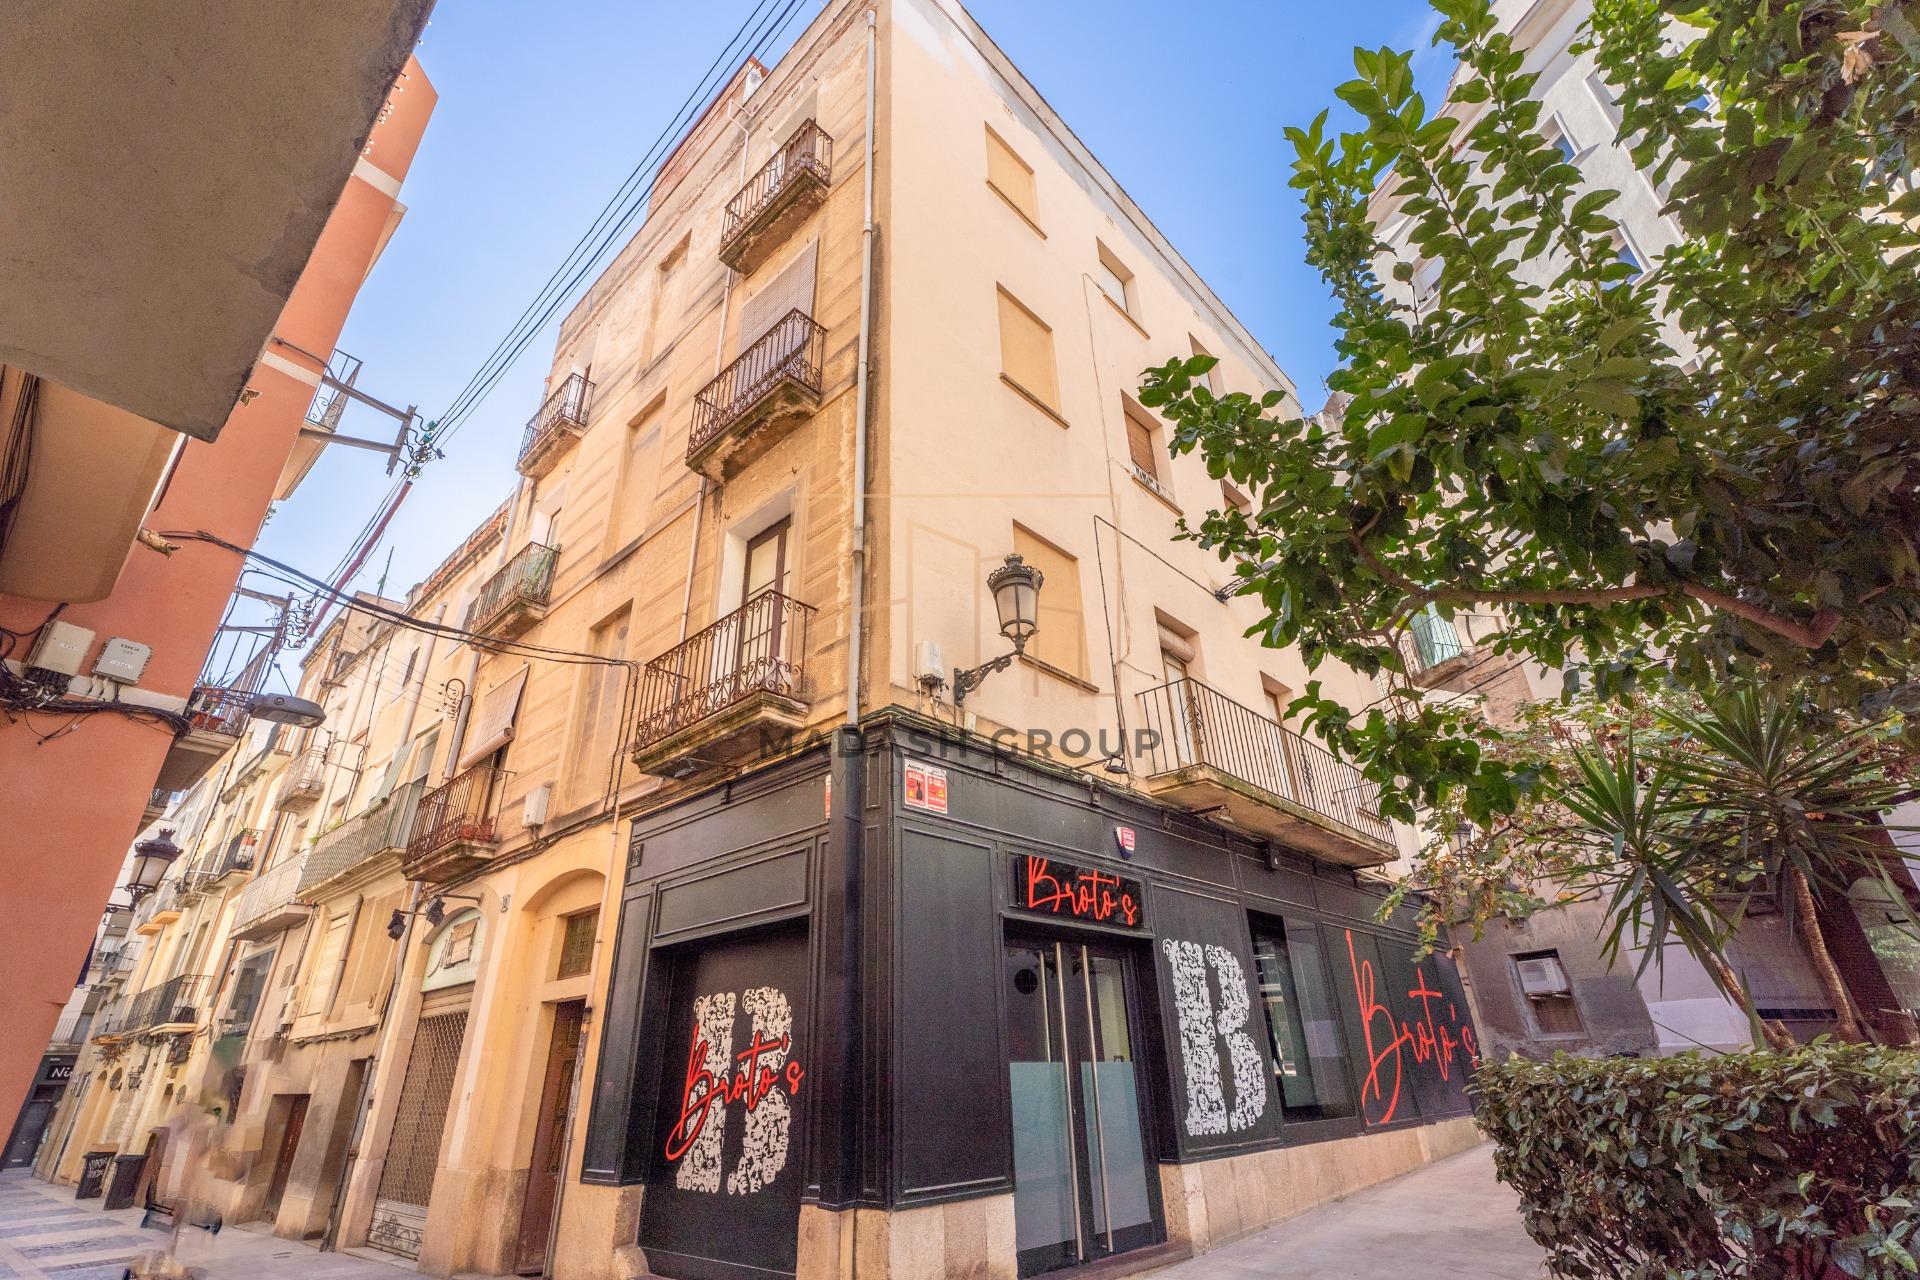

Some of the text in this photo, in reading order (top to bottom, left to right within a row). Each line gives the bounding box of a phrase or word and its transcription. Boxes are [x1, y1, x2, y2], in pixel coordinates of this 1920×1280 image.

[1027, 855, 1138, 927] Broto's
[665, 1022, 806, 1161] Broto's
[1346, 928, 1479, 1125] Broto's
